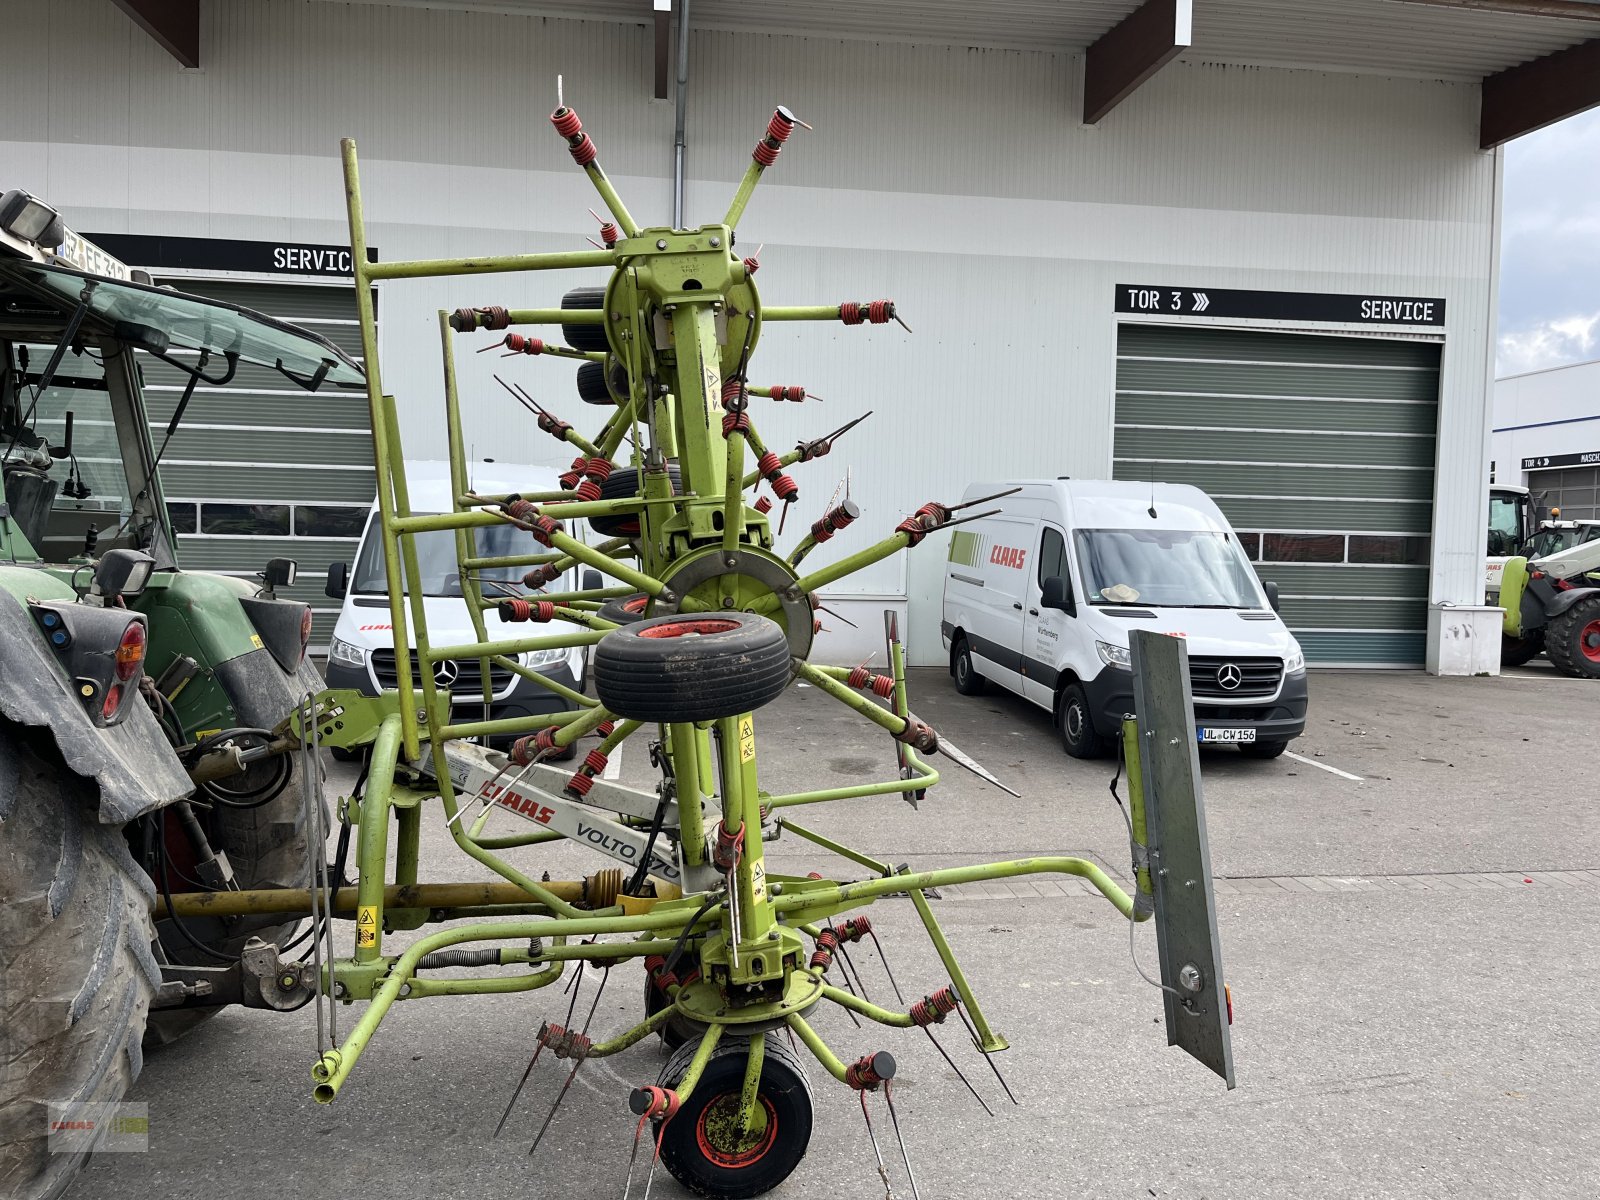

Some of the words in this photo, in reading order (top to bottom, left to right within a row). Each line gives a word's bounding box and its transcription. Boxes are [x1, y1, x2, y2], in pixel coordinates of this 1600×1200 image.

[65, 231, 79, 265] GZ
[86, 246, 101, 275] EF
[274, 247, 355, 272] SERVIC
[1128, 289, 1160, 310] TOR
[1171, 291, 1182, 311] 3
[1360, 300, 1434, 321] SERVICE
[1525, 459, 1535, 468] TOR
[990, 544, 1026, 570] CLAAS
[1204, 729, 1217, 740] UL
[1222, 729, 1236, 740] CW
[1237, 730, 1255, 740] 156
[480, 780, 556, 824] CLAAS
[577, 822, 637, 859] VOLTO
